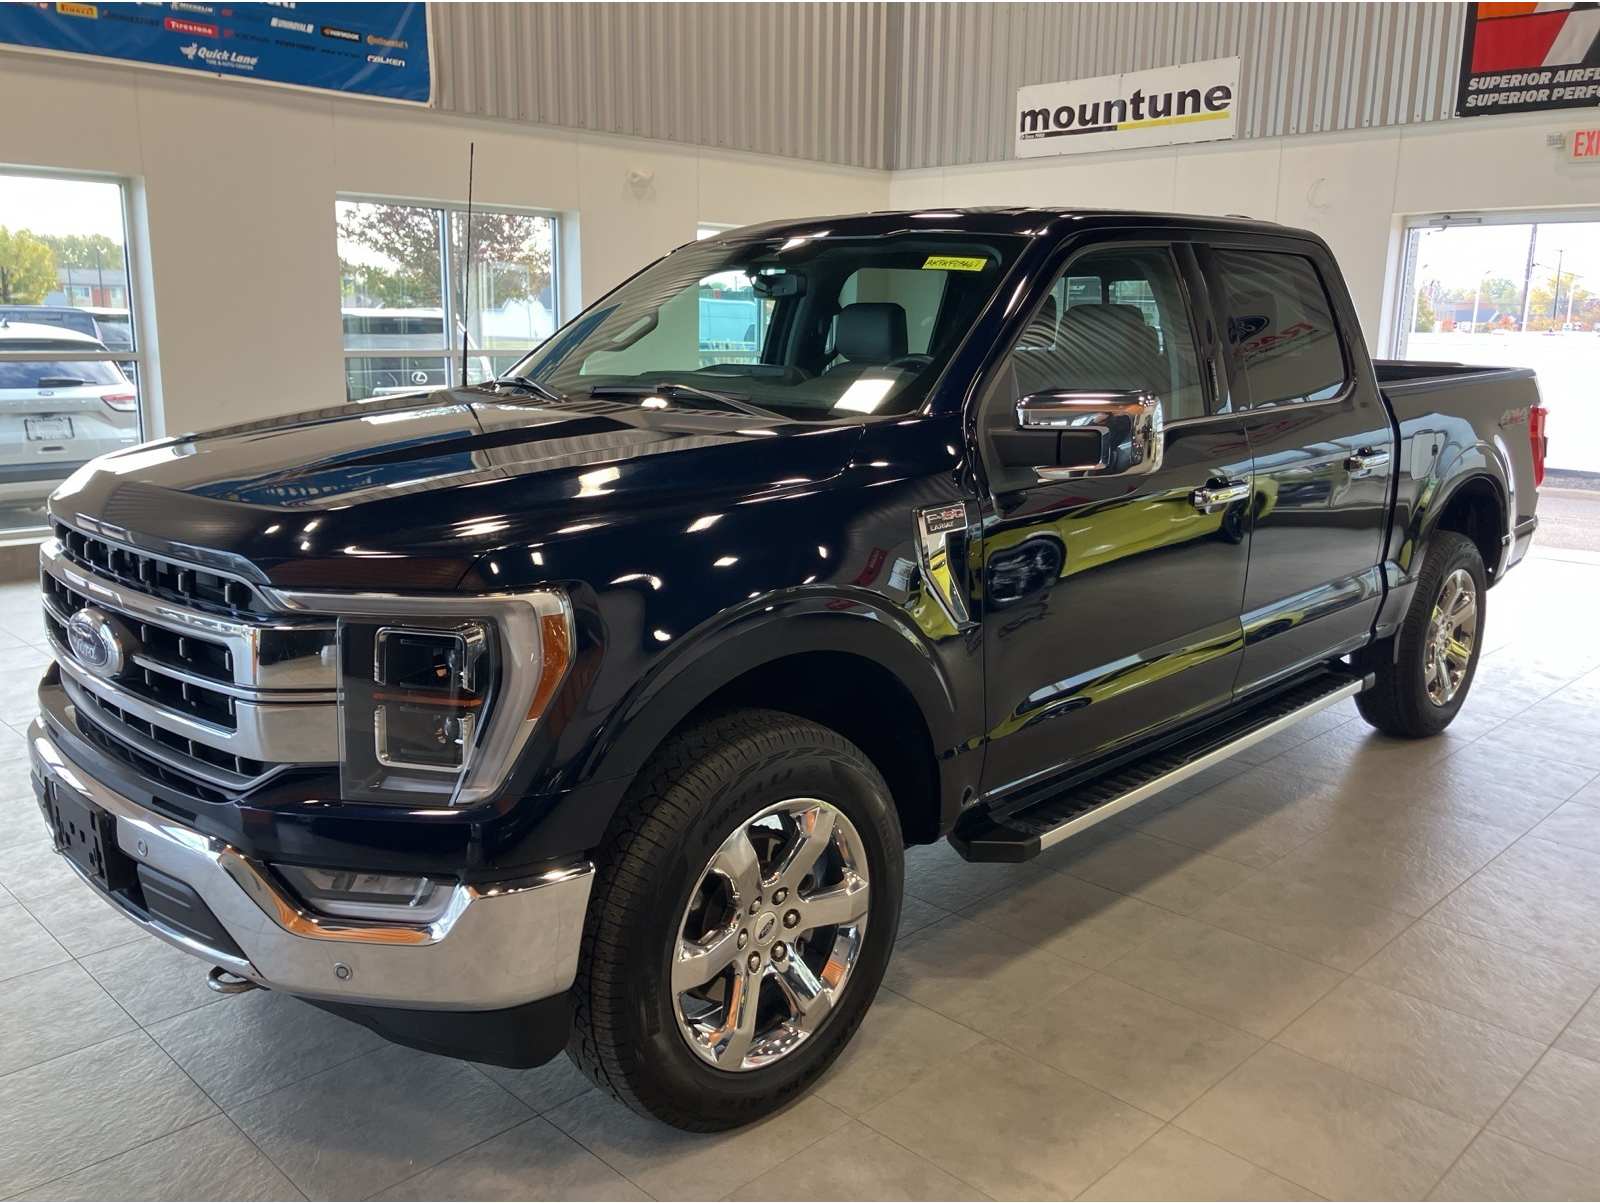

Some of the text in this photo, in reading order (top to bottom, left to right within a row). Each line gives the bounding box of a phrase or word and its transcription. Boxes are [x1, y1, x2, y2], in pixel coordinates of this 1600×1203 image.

[197, 46, 258, 65] Quick Lane
[1467, 72, 1551, 90] SUPERIOR
[1466, 89, 1550, 107] SUPERIOR
[1020, 85, 1232, 132] mountune
